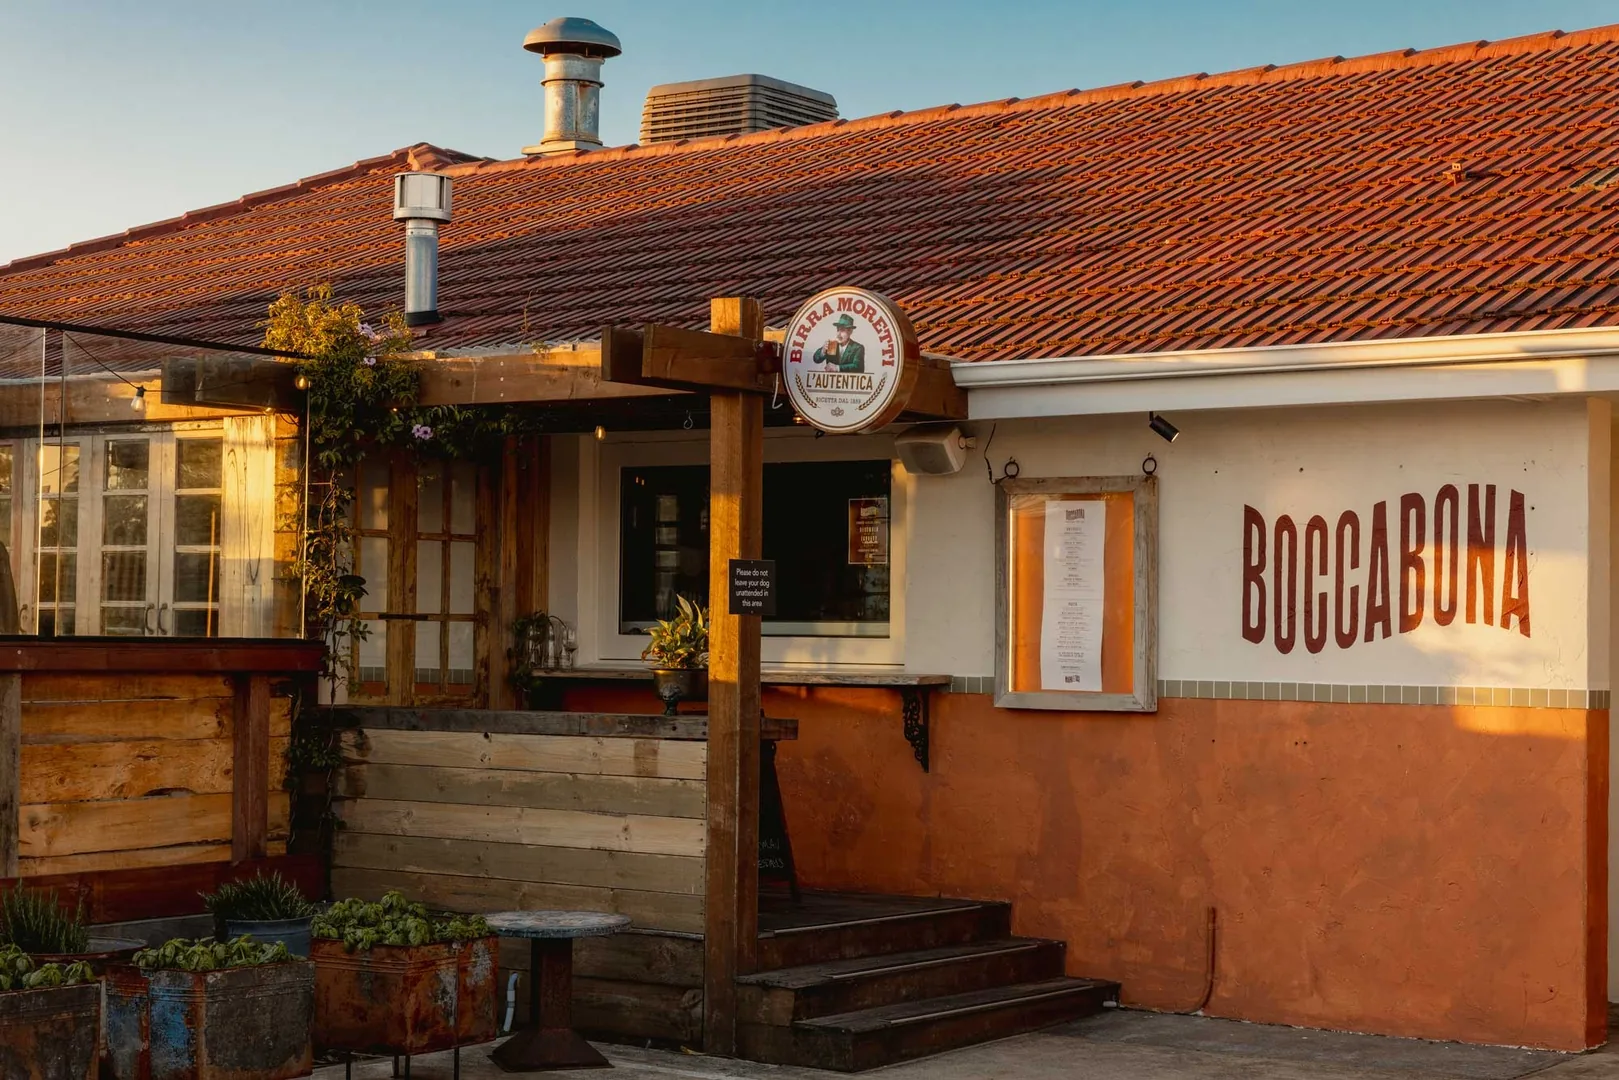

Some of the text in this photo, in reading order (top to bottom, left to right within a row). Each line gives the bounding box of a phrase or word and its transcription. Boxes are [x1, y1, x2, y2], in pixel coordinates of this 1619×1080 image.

[790, 298, 895, 367] BIRRA MORETTI
[806, 374, 873, 390] L'AUTENTICA
[736, 568, 751, 576] Please
[752, 568, 759, 576] do
[1242, 484, 1531, 655] BOCCABONA
[735, 578, 770, 588] leave your dog
[736, 589, 763, 597] unattended
[742, 599, 751, 607] this
